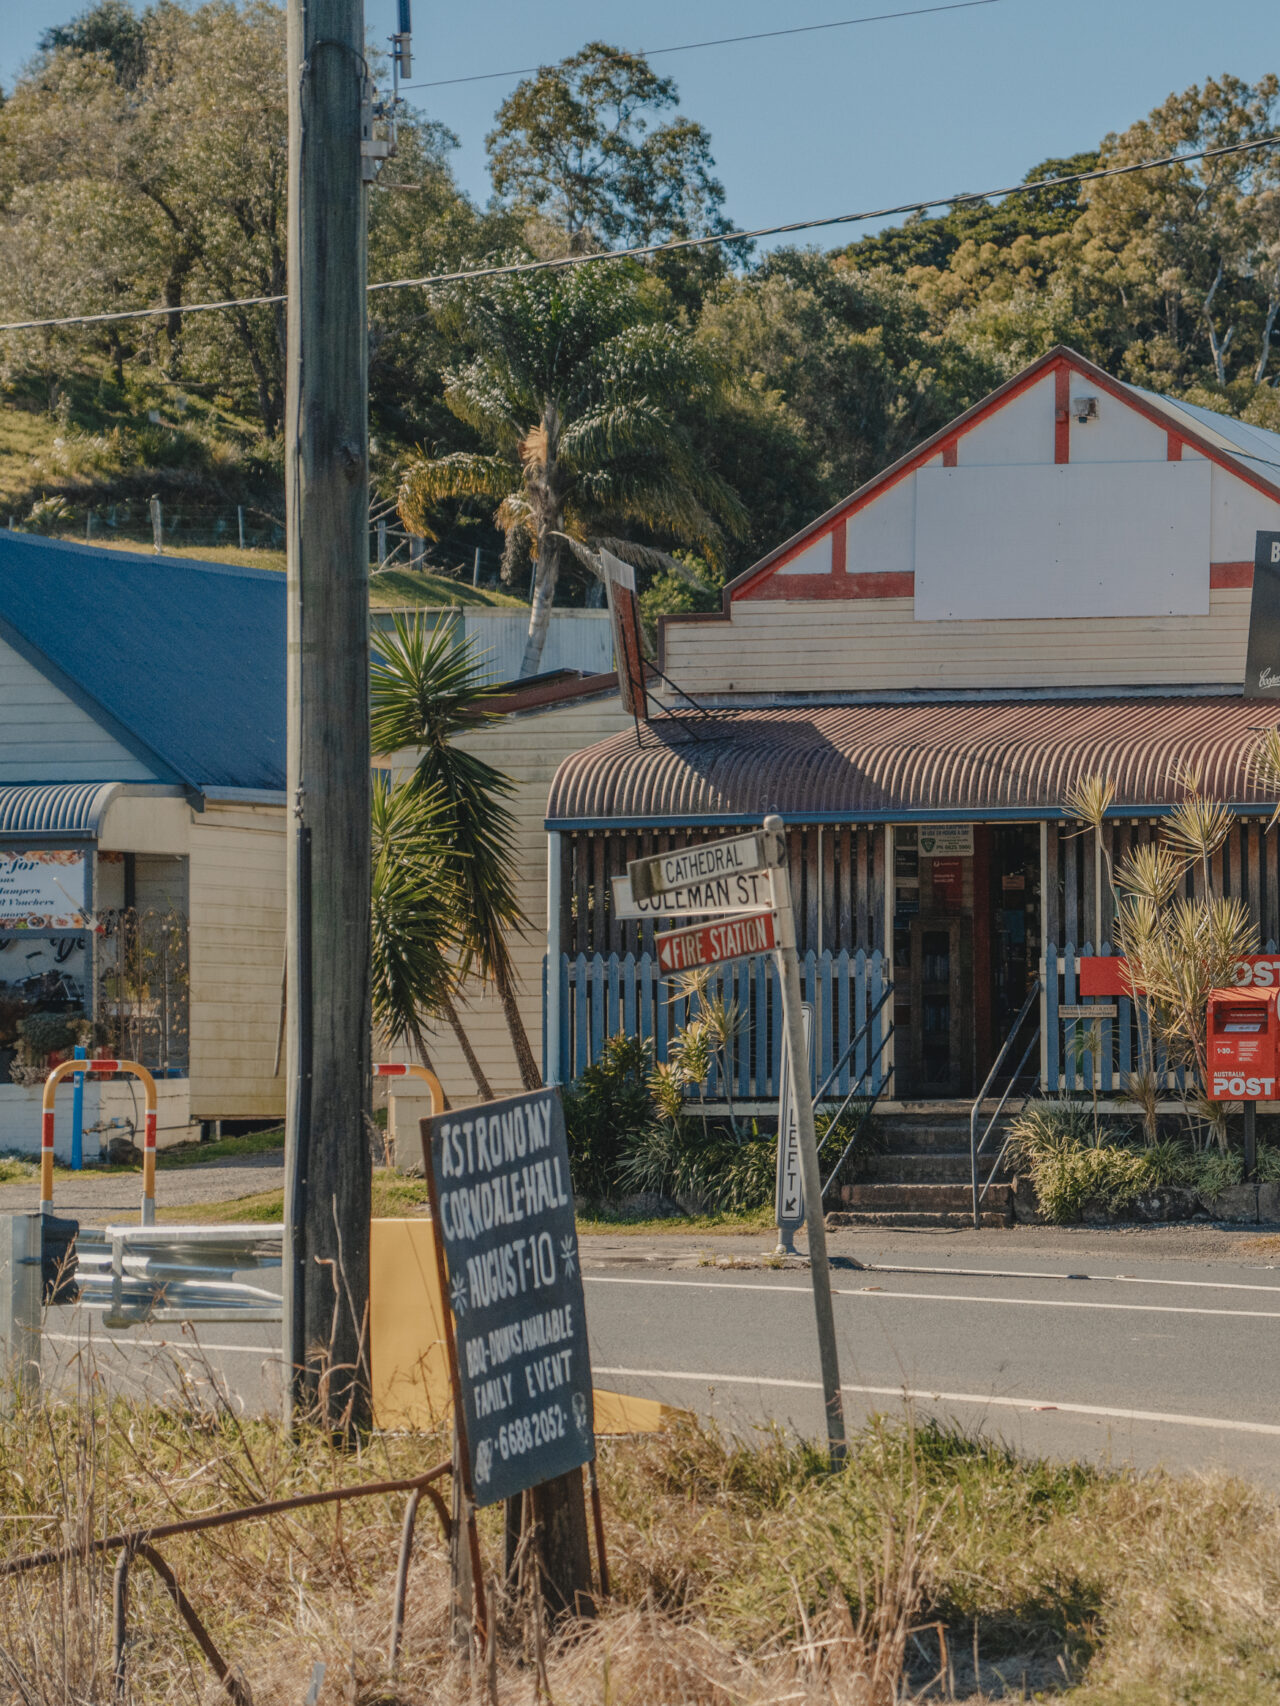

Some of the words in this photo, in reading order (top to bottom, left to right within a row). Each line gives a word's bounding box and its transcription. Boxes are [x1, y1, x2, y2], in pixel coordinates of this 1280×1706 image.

[6, 858, 39, 874] for
[665, 843, 743, 884] CATHEDRAL
[736, 874, 759, 905] ST
[671, 929, 706, 969] FIRE
[709, 916, 768, 961] STATION
[1213, 1077, 1276, 1096] POST
[440, 1099, 551, 1179] ASTRONOMY
[787, 1108, 797, 1191] LEFT
[521, 1304, 574, 1352] AVAILABLE
[473, 1372, 513, 1420] FAMILY
[524, 1349, 573, 1398] EVENT
